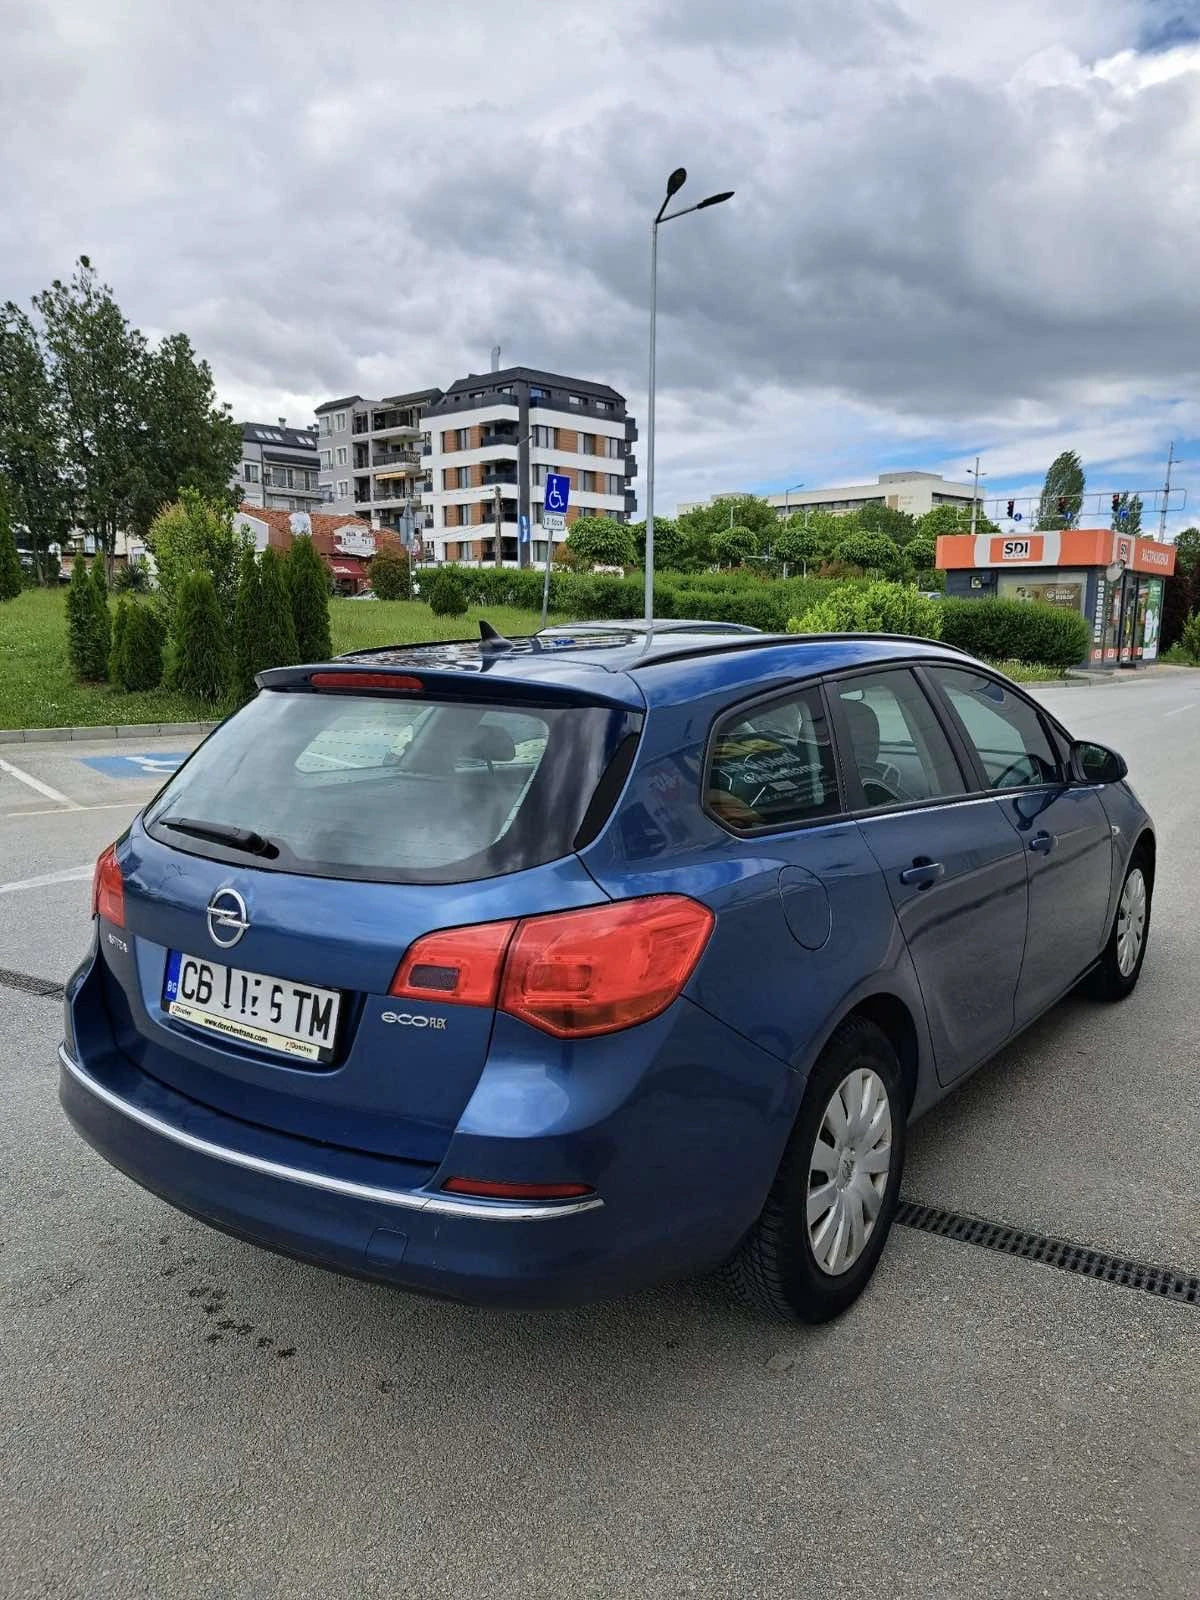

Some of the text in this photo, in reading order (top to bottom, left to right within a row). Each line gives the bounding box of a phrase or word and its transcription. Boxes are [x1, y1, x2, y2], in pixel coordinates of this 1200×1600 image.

[1004, 542, 1028, 554] SDI
[167, 980, 177, 993] BG
[293, 989, 333, 1040] TM
